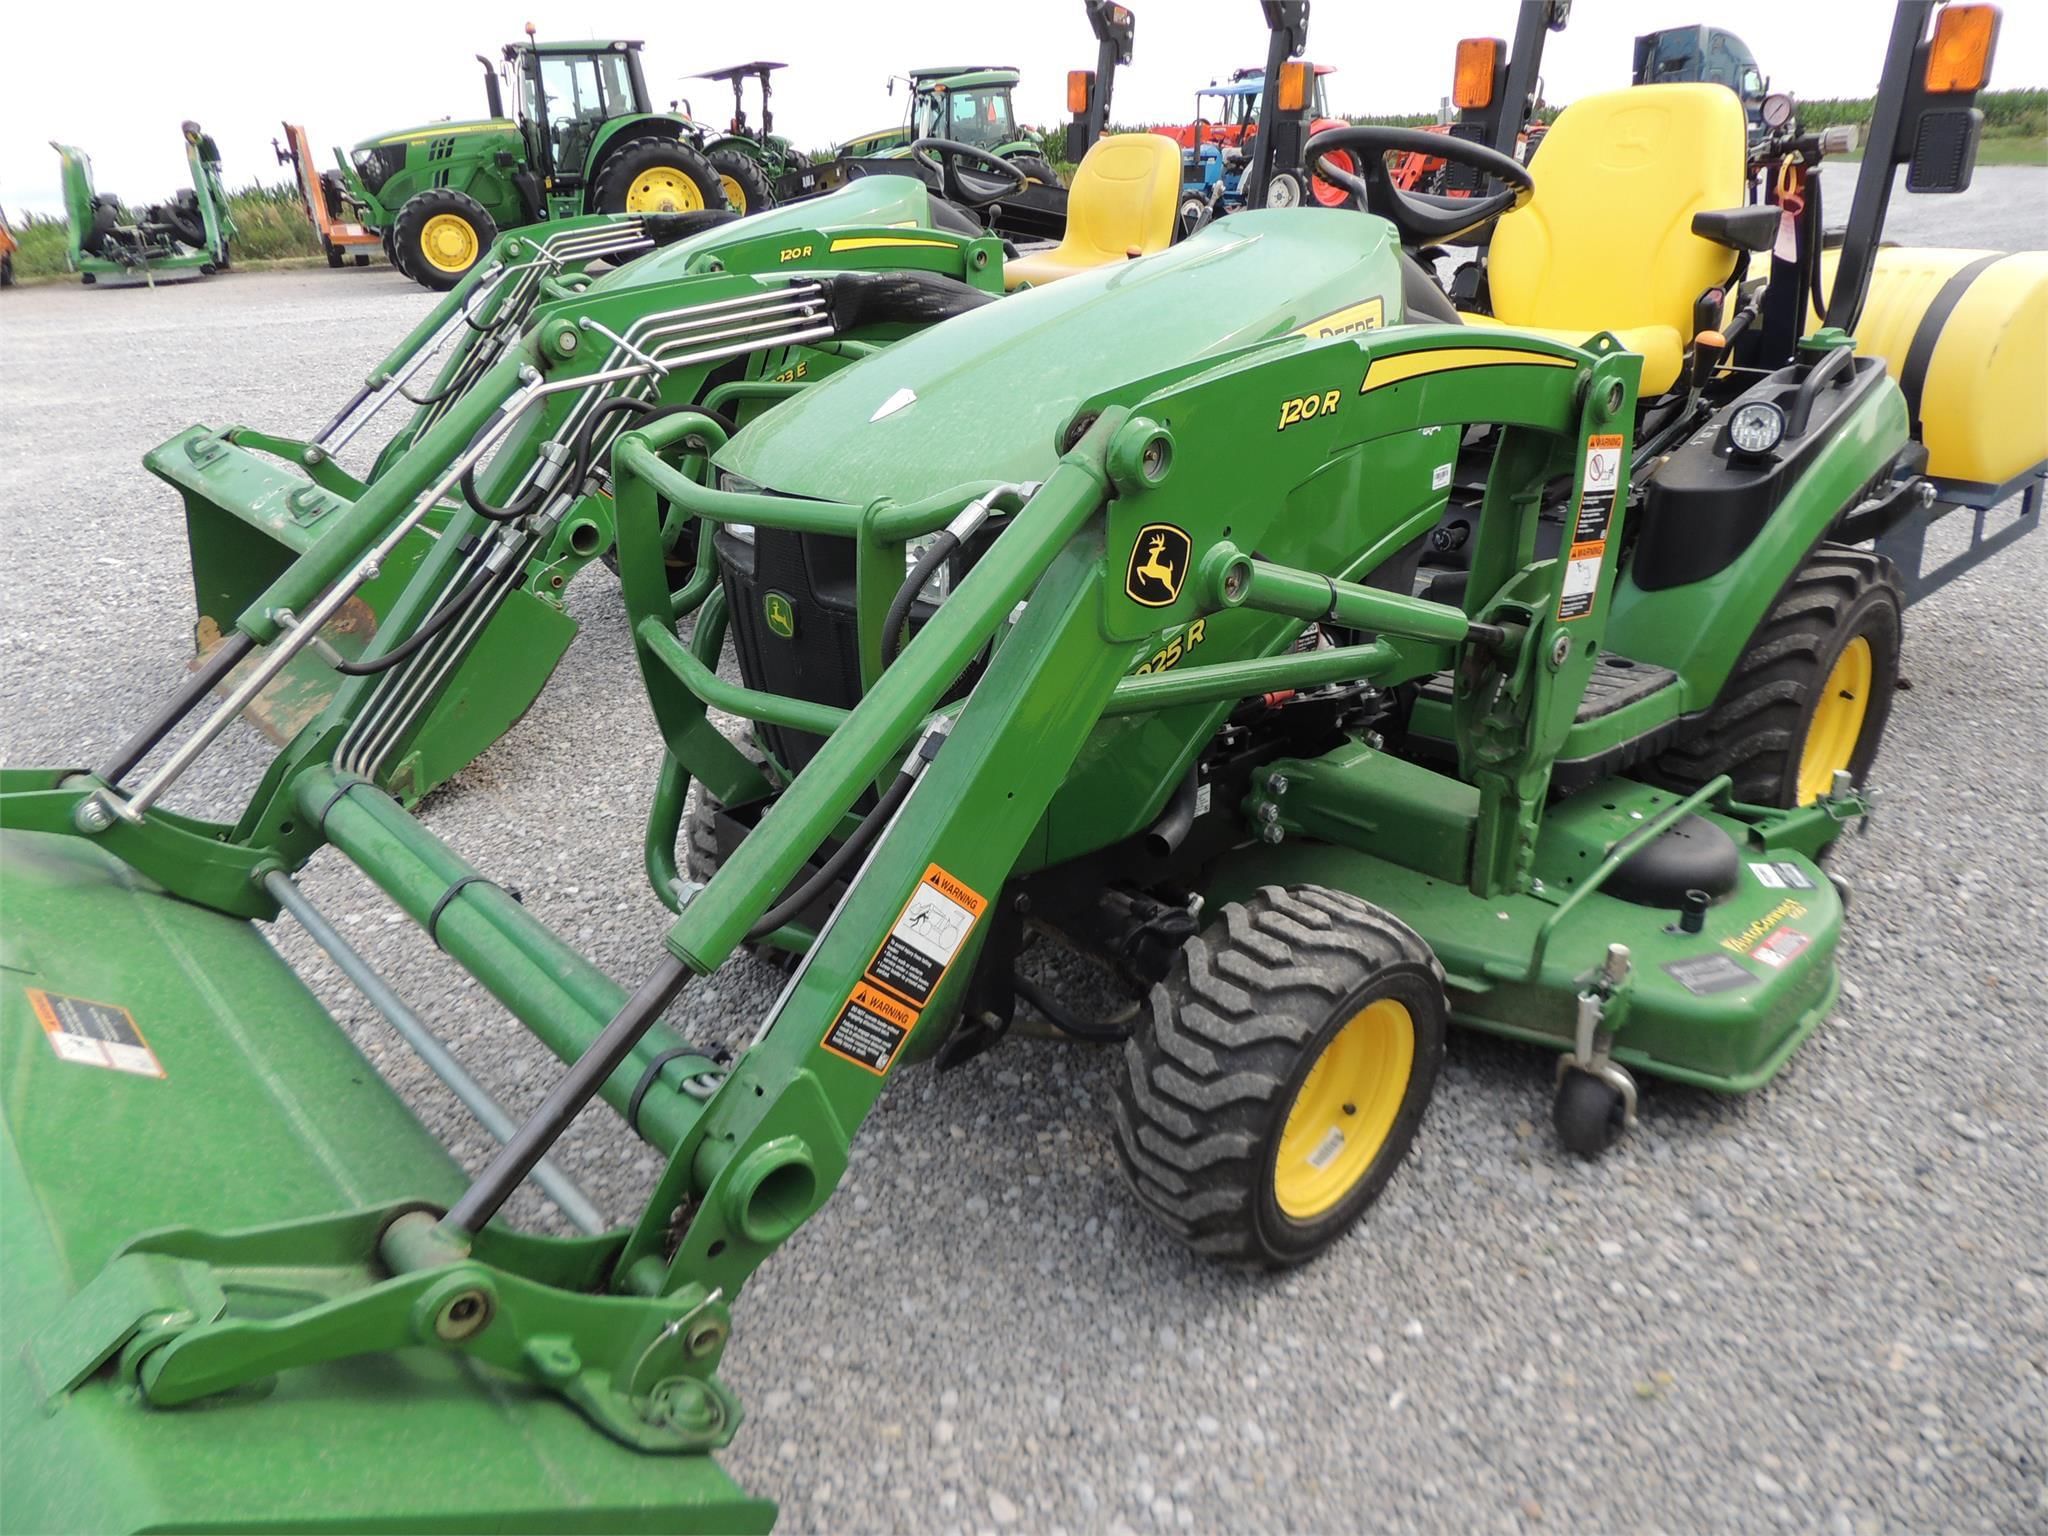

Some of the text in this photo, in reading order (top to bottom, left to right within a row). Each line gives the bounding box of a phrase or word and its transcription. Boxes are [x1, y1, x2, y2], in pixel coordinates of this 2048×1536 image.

[780, 245, 813, 263] 120 R
[797, 361, 807, 378] E
[1278, 390, 1341, 431] 120 R
[1187, 618, 1206, 653] R
[940, 878, 978, 910] WARNING
[870, 996, 909, 1024] WARNING
